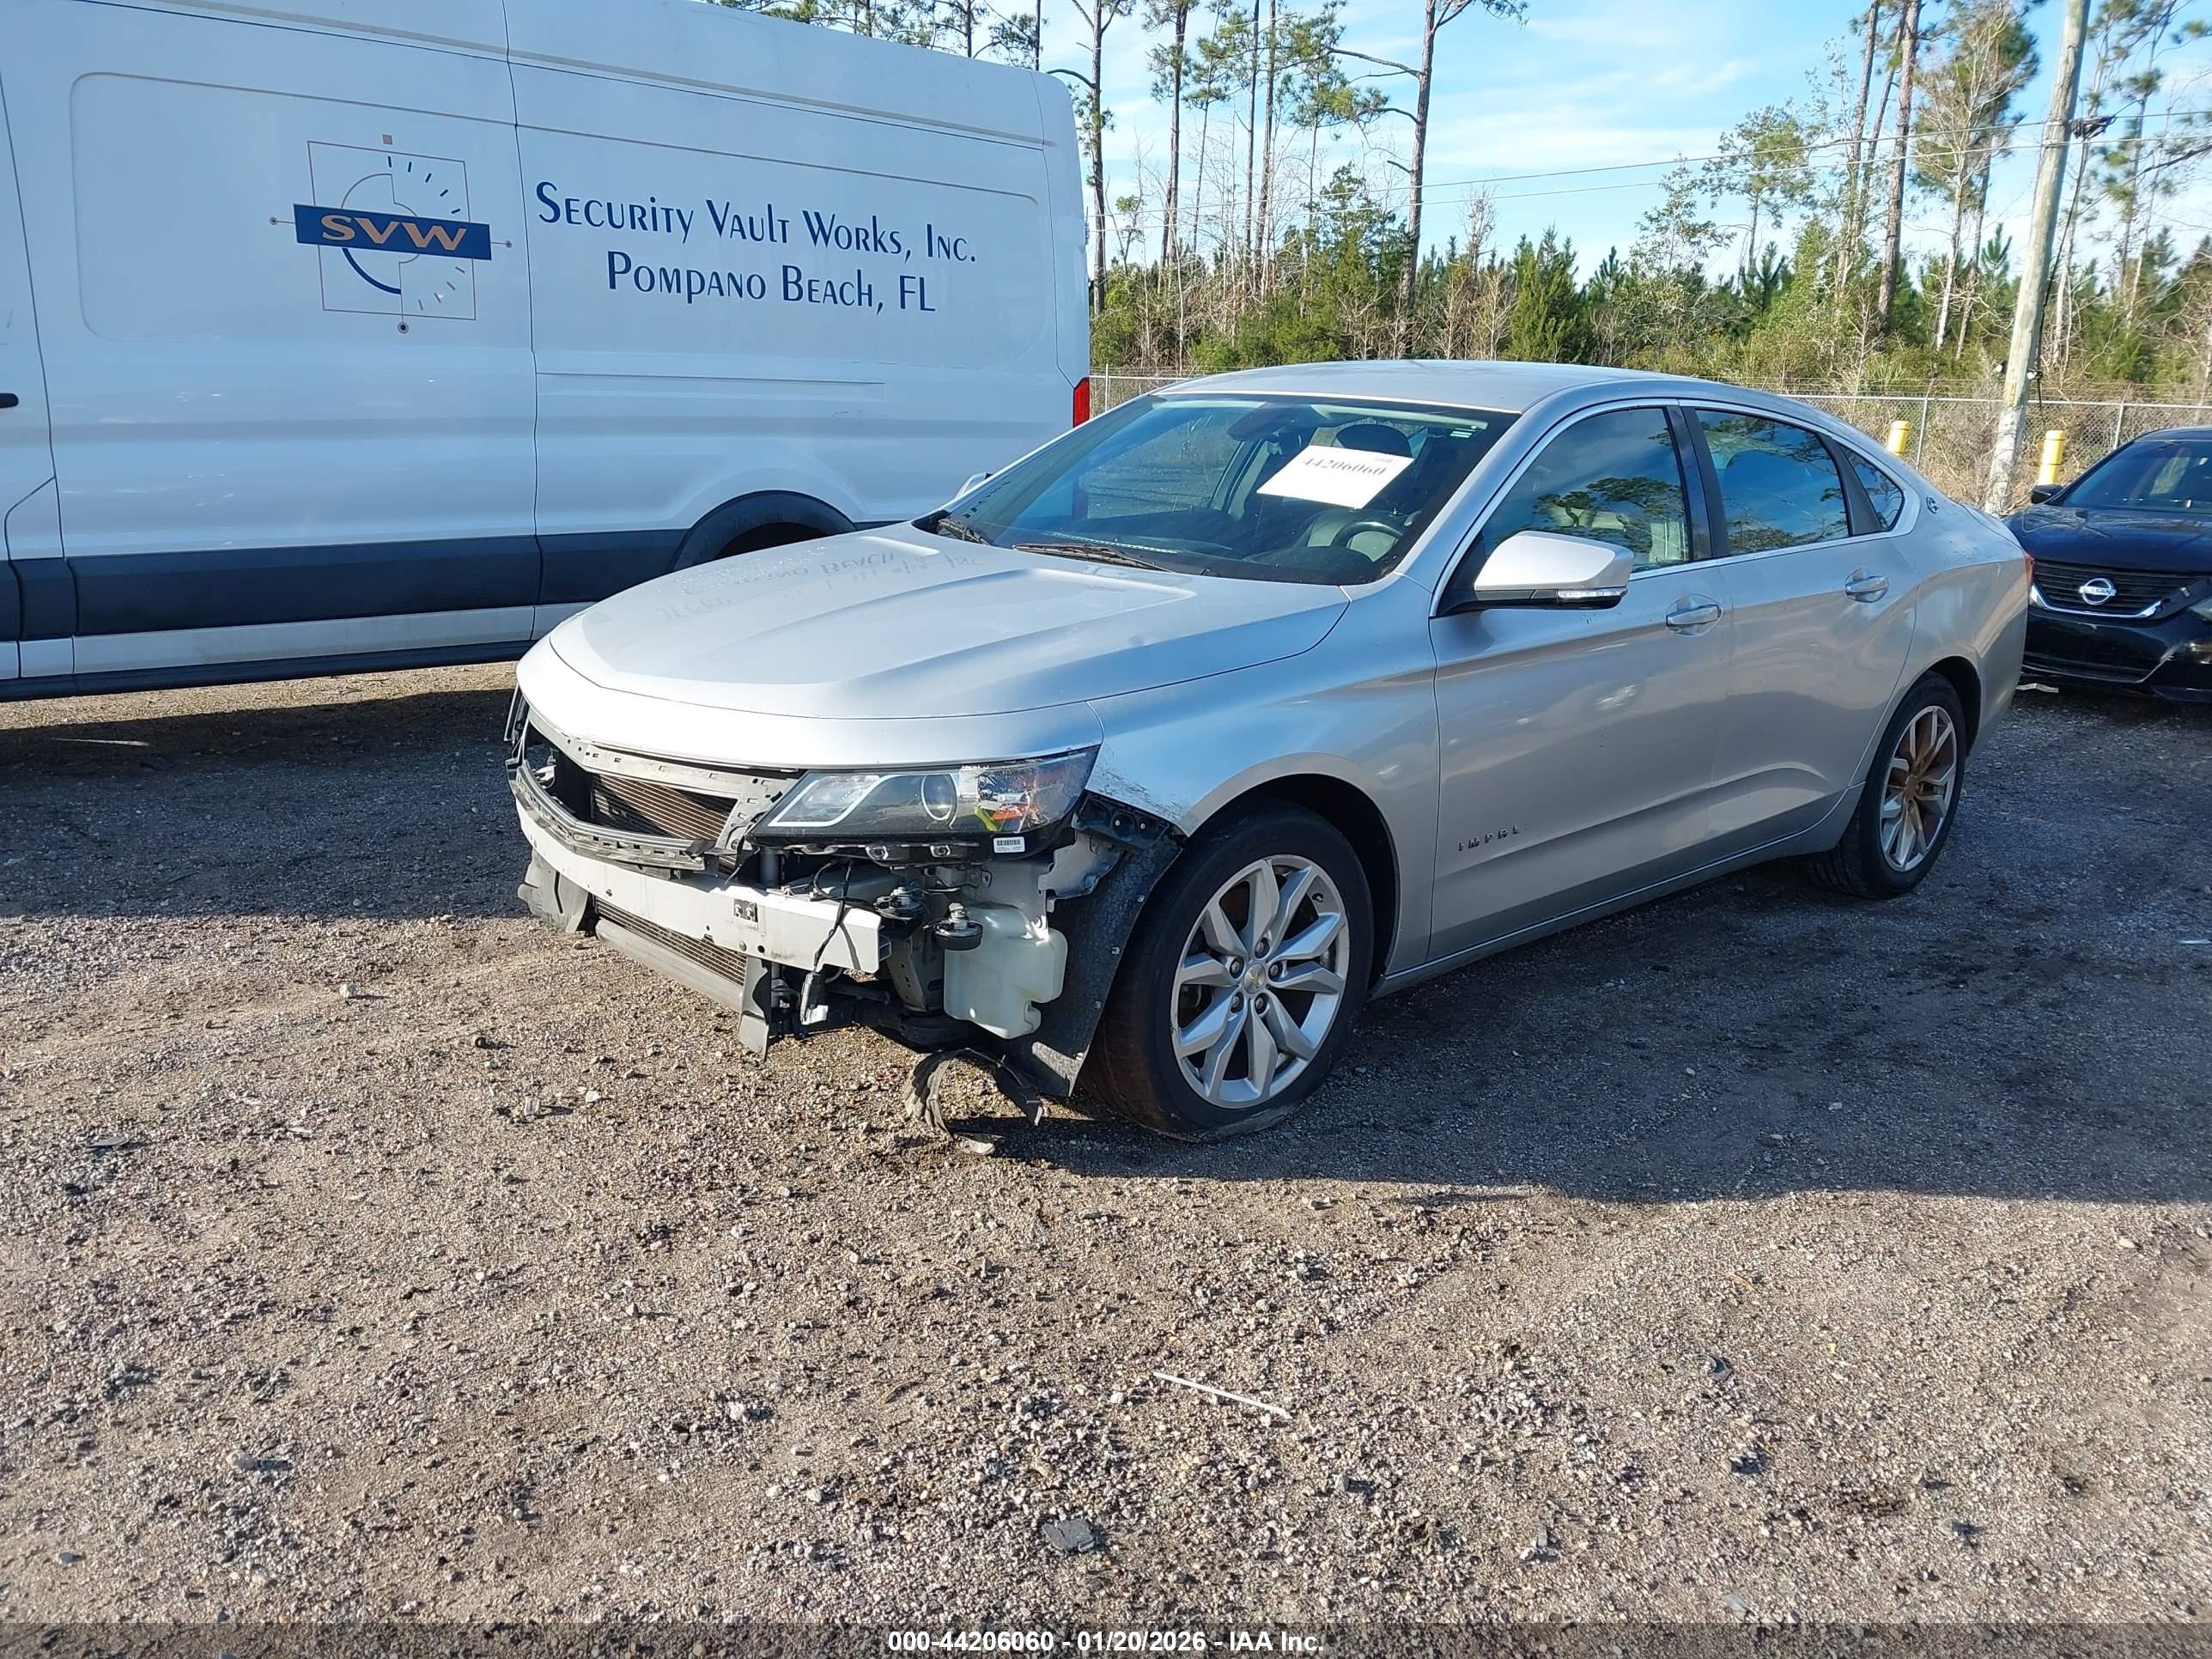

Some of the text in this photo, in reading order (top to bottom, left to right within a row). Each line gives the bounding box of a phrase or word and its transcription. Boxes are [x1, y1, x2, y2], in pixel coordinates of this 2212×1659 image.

[320, 214, 468, 252] SVW
[898, 275, 937, 313] FL
[1304, 457, 1387, 476] 44206060
